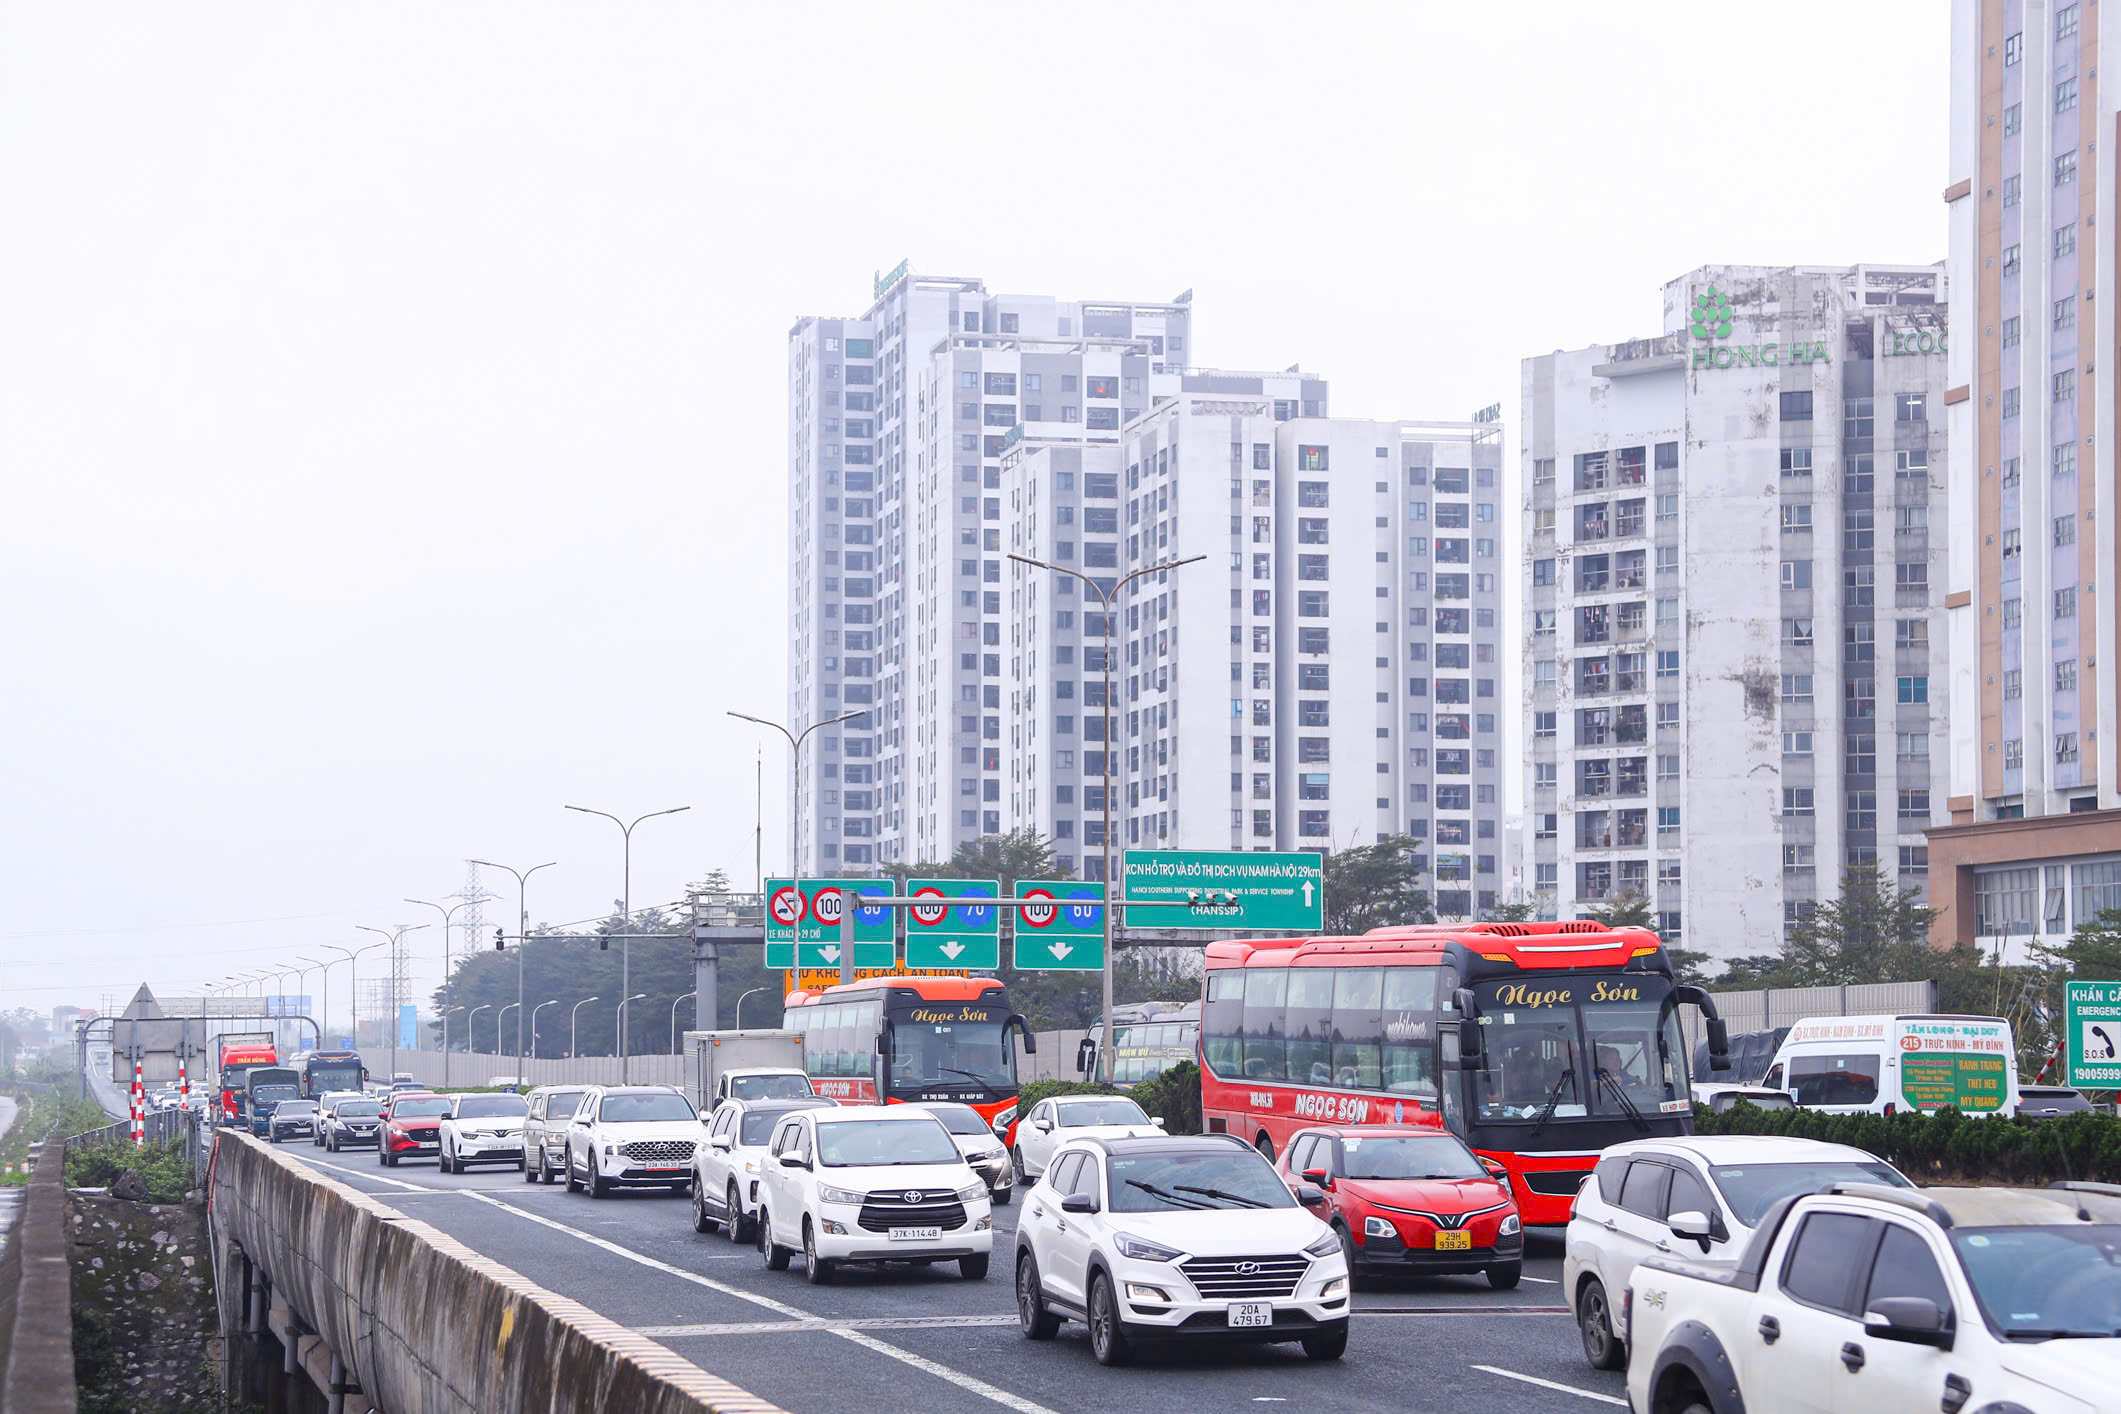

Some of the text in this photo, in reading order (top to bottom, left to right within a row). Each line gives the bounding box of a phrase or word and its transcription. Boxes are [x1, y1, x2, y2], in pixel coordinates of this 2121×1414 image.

[1893, 332, 1934, 355] ECO
[1692, 342, 1830, 369] HONG HA
[1126, 864, 1144, 875] KCN
[1159, 864, 1175, 877] TRỢ
[1176, 860, 1187, 876] VÀ
[1215, 865, 1235, 878] DỊCH
[1236, 865, 1248, 878] VỤ
[1249, 865, 1268, 877] NAM
[1270, 863, 1281, 877] HÀ
[1282, 863, 1297, 879] NỘI
[1298, 865, 1320, 878] 29km
[1148, 886, 1173, 894] SOUTHERN
[1249, 888, 1268, 896] SERVICE
[1270, 888, 1294, 896] TOWNSHIP
[820, 898, 842, 915] 100
[1191, 906, 1244, 916] (HANSSIP)
[769, 929, 776, 938] XE
[1495, 981, 1640, 1008] Ngọc Sơn
[2072, 984, 2103, 1002] KHẨN
[911, 1007, 988, 1024] Ngọc Sơn
[1927, 1026, 1954, 1034] LONG
[1902, 1038, 1920, 1048] 215
[1947, 1040, 1965, 1049] NINH
[2084, 1049, 2105, 1059] S.O.S
[2074, 1067, 2121, 1080] 19005999
[1294, 1094, 1369, 1123] NGỌC SƠN
[893, 1229, 937, 1238] 37K-114.48
[1445, 1232, 1461, 1241] 29H
[1439, 1240, 1467, 1249] 939.25
[1240, 1305, 1260, 1315] 20A
[1233, 1315, 1268, 1326] 479.67
